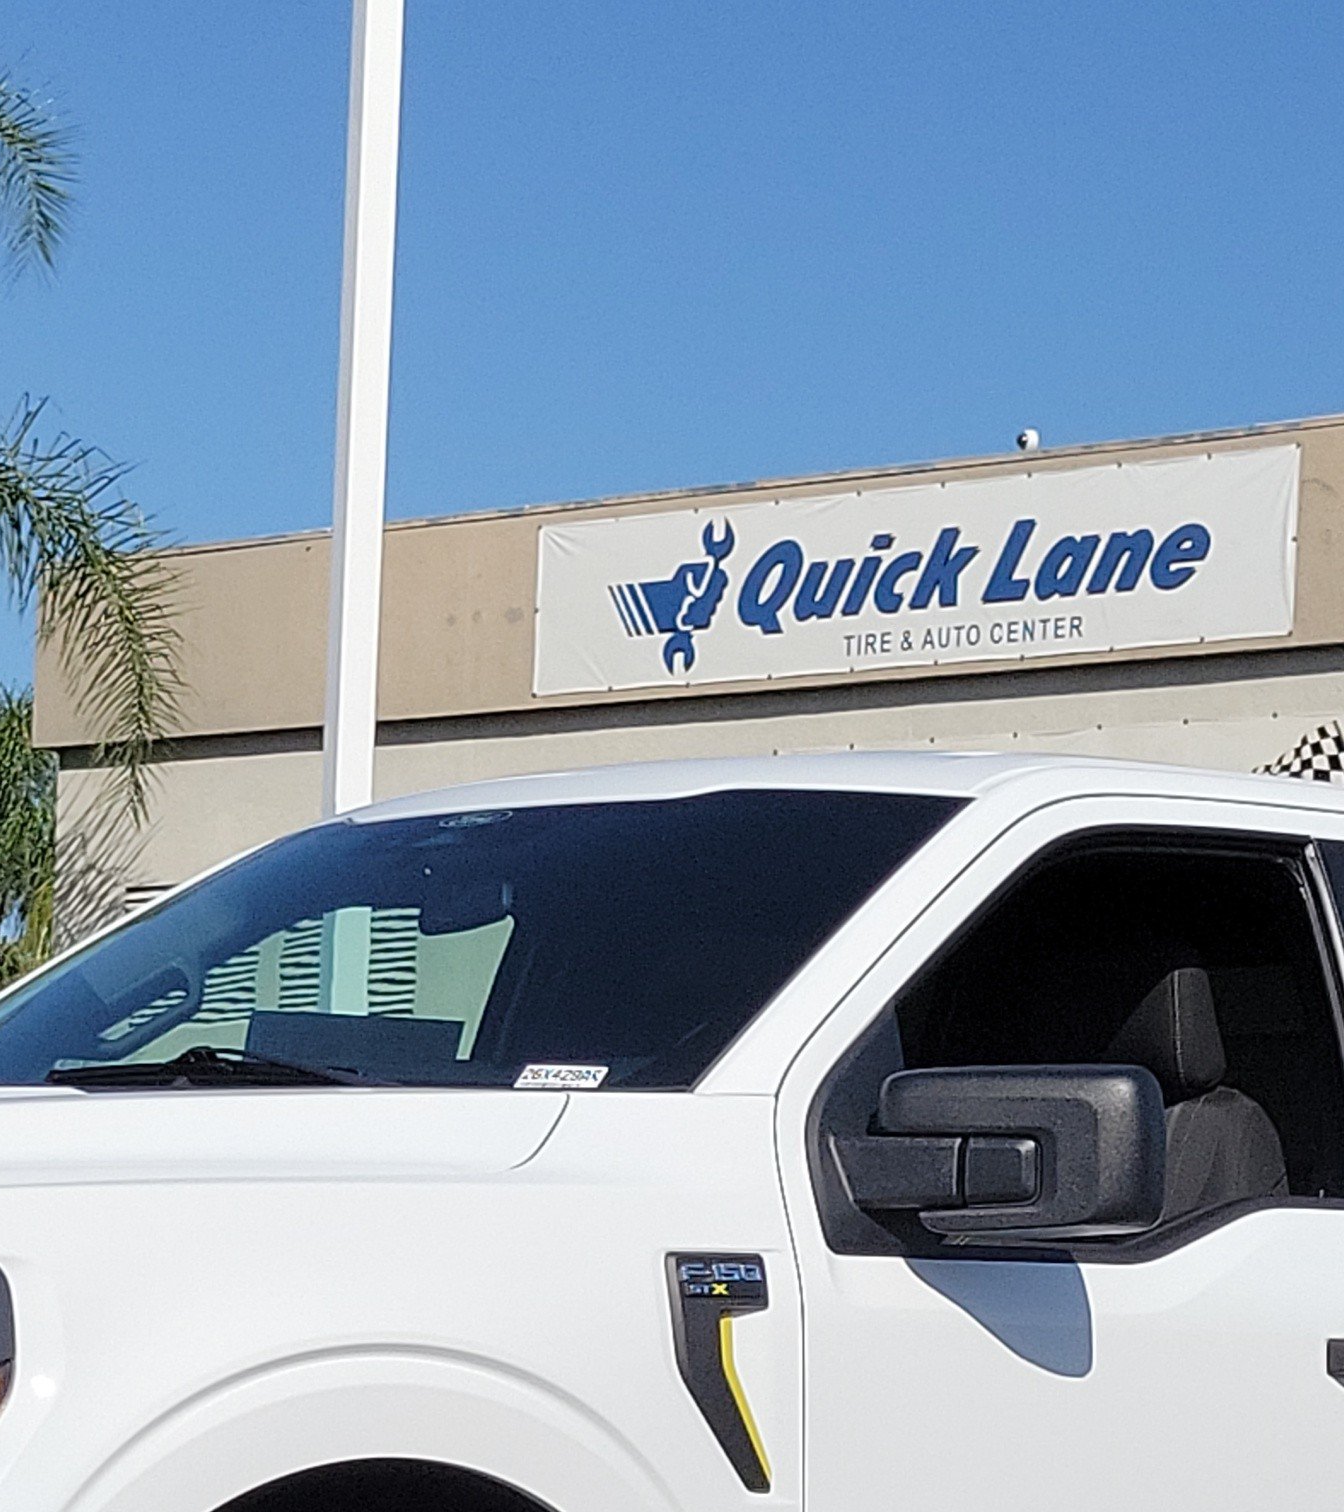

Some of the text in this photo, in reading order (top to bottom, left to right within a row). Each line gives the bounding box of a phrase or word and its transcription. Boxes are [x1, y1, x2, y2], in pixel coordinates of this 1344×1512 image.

[736, 518, 1213, 634] Quick Lane
[843, 615, 1084, 657] TIRE & AUTO CENTER
